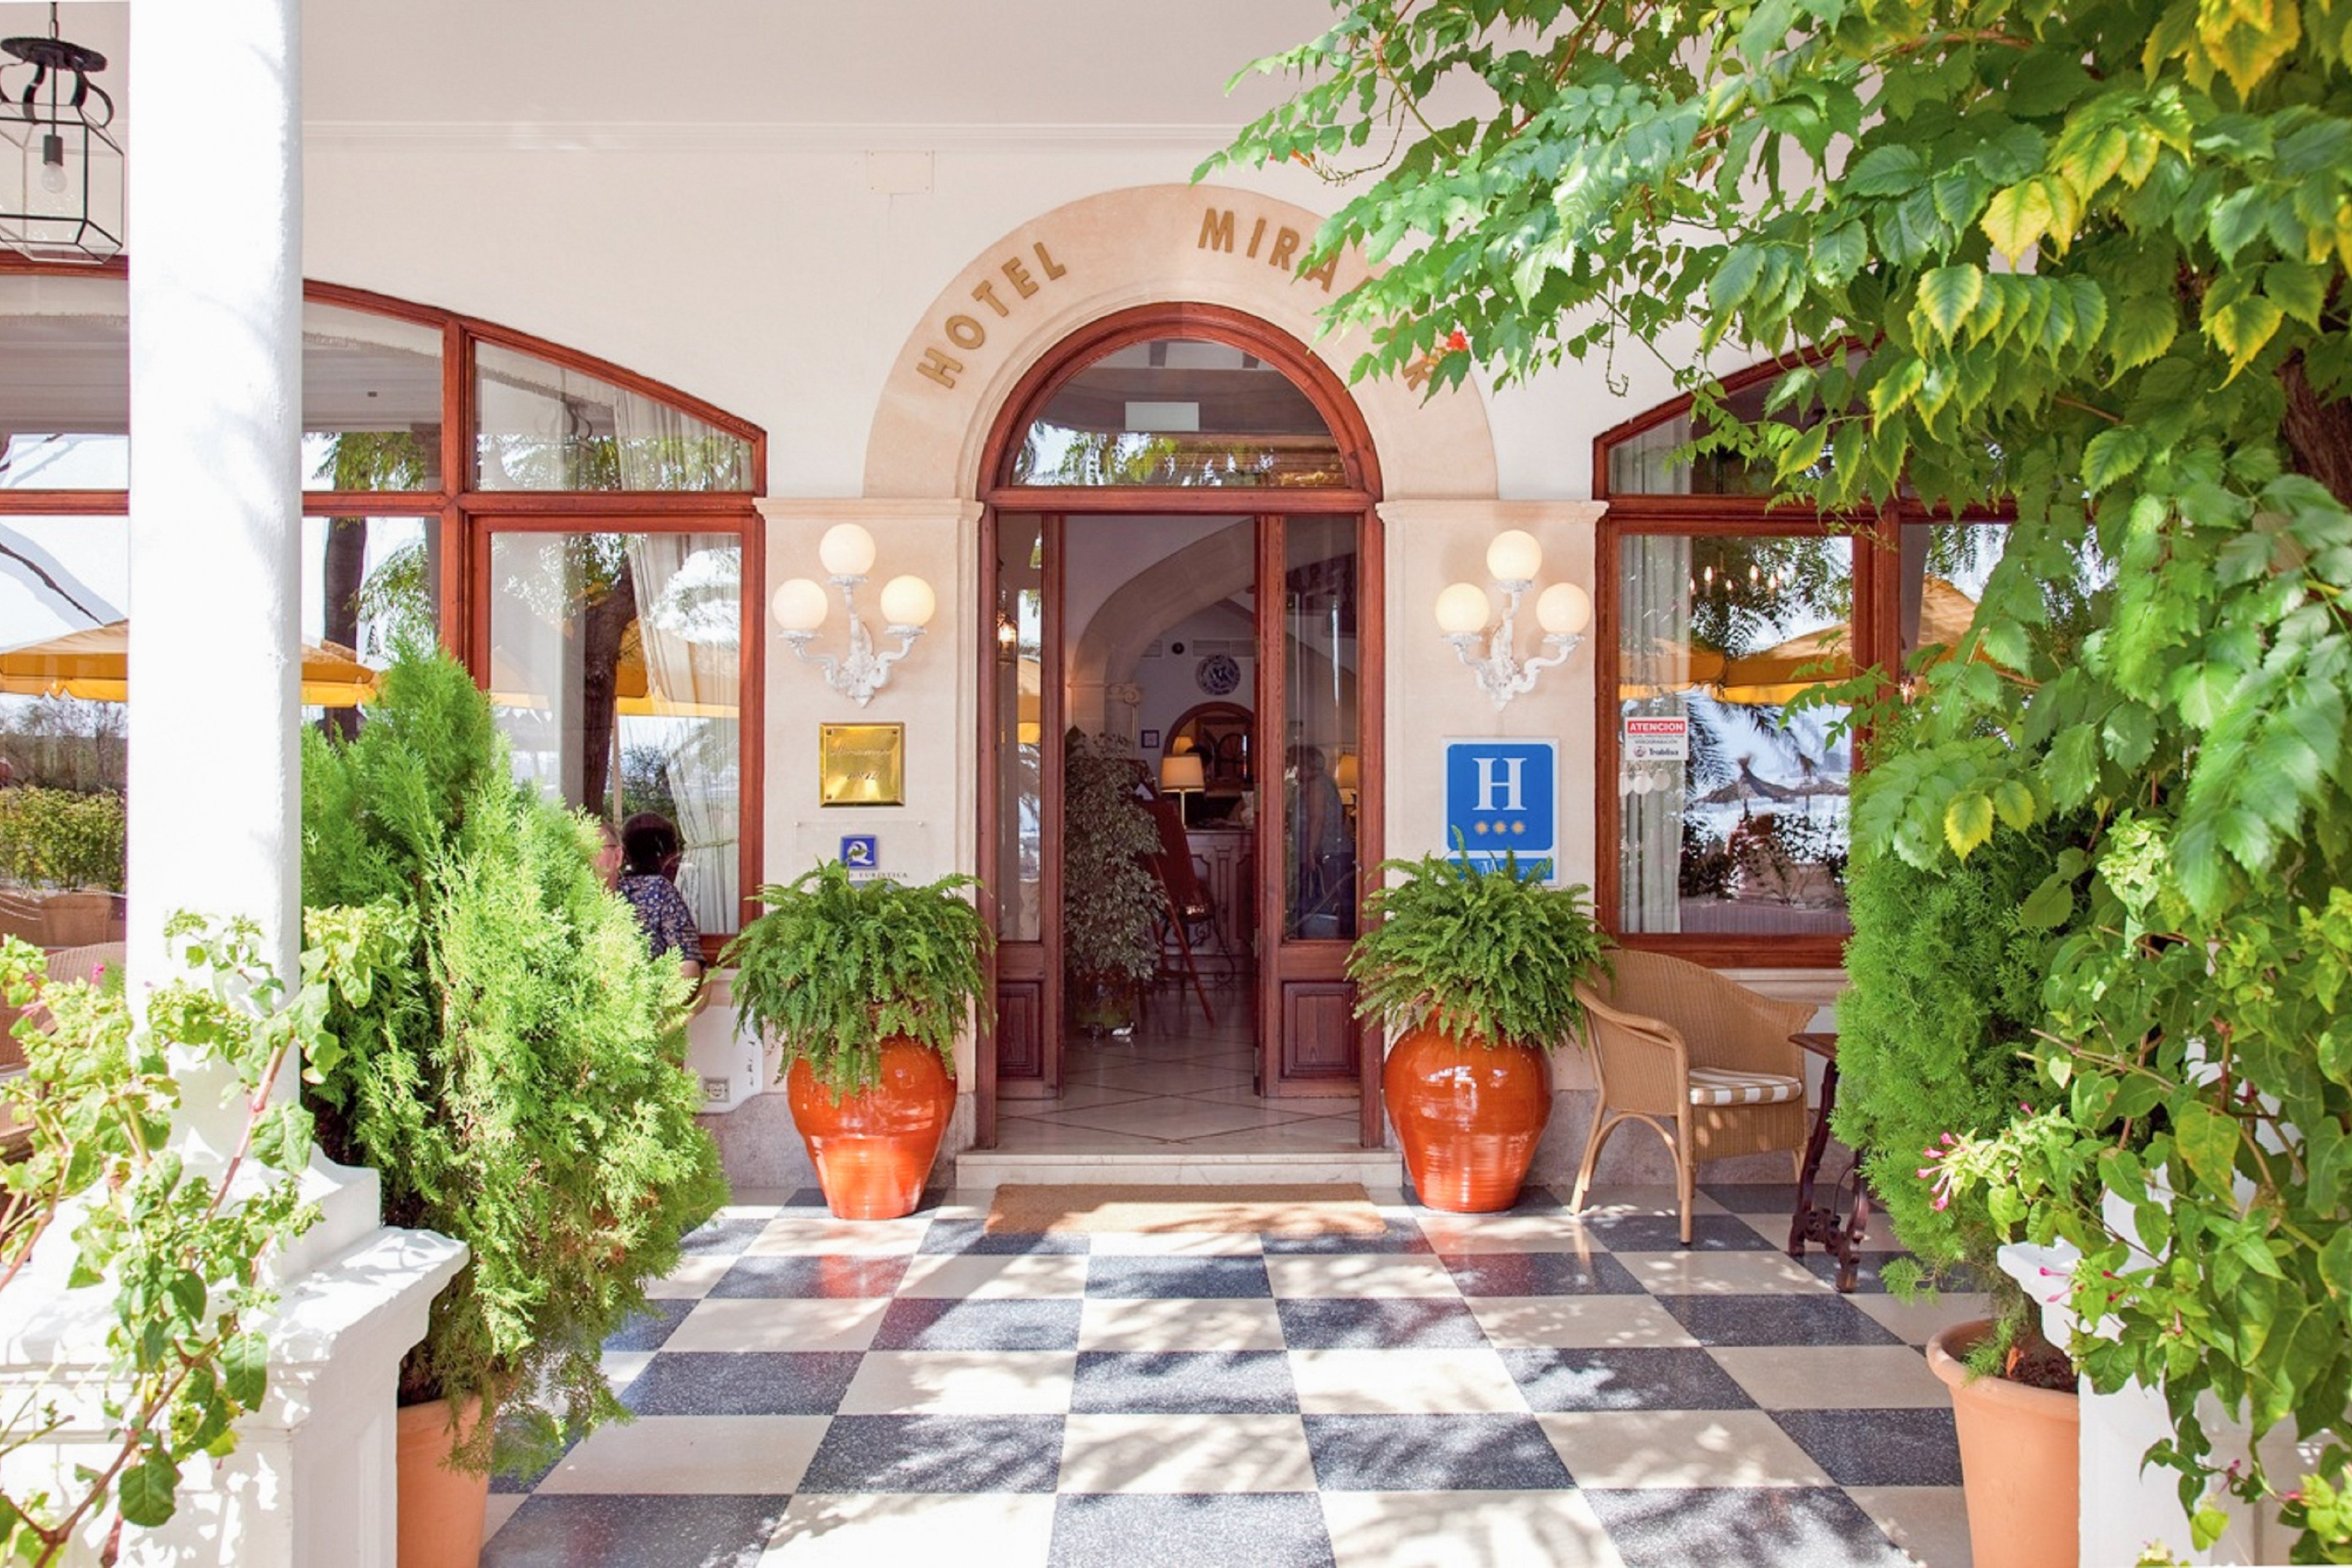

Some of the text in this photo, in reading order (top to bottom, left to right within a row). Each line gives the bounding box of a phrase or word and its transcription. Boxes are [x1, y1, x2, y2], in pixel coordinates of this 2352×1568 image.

[916, 241, 1067, 389] HOTEL
[1629, 722, 1683, 731] ATENCION
[1472, 758, 1528, 811] H
